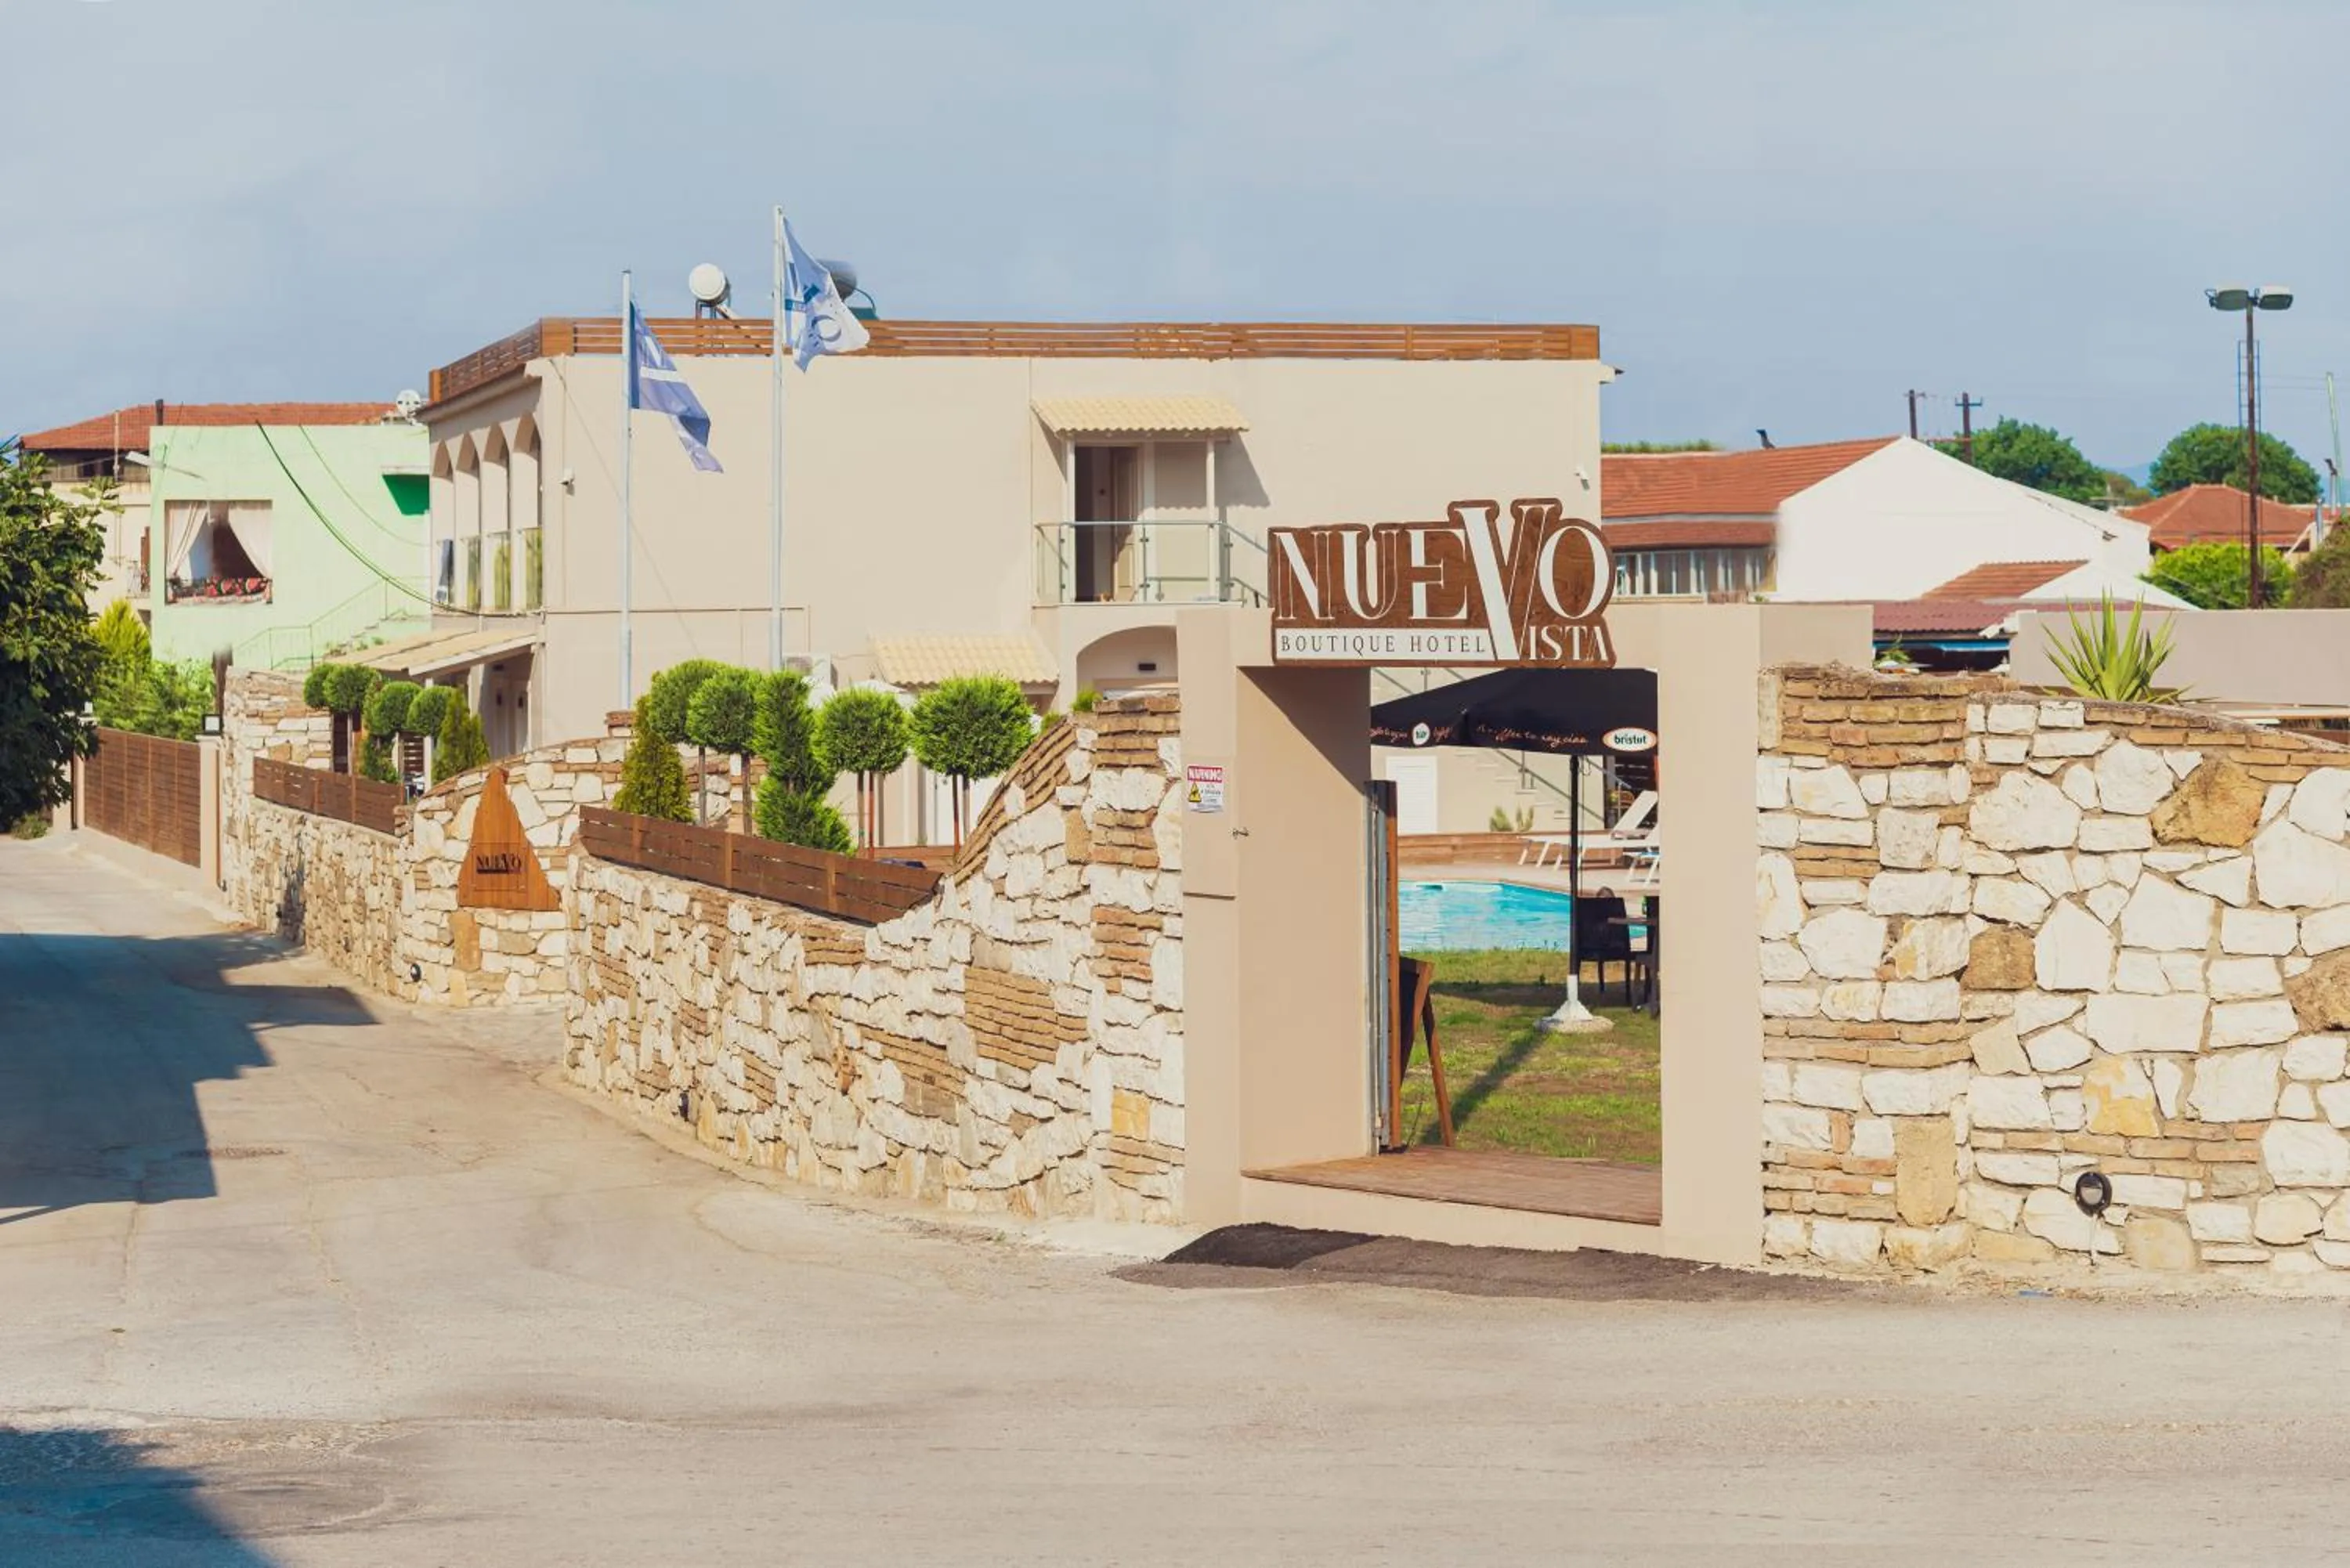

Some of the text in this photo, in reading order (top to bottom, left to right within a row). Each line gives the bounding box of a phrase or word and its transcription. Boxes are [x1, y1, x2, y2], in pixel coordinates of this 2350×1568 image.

[1274, 503, 1611, 661] NUEVO
[1280, 634, 1487, 659] BOUTIQUE HOTEL
